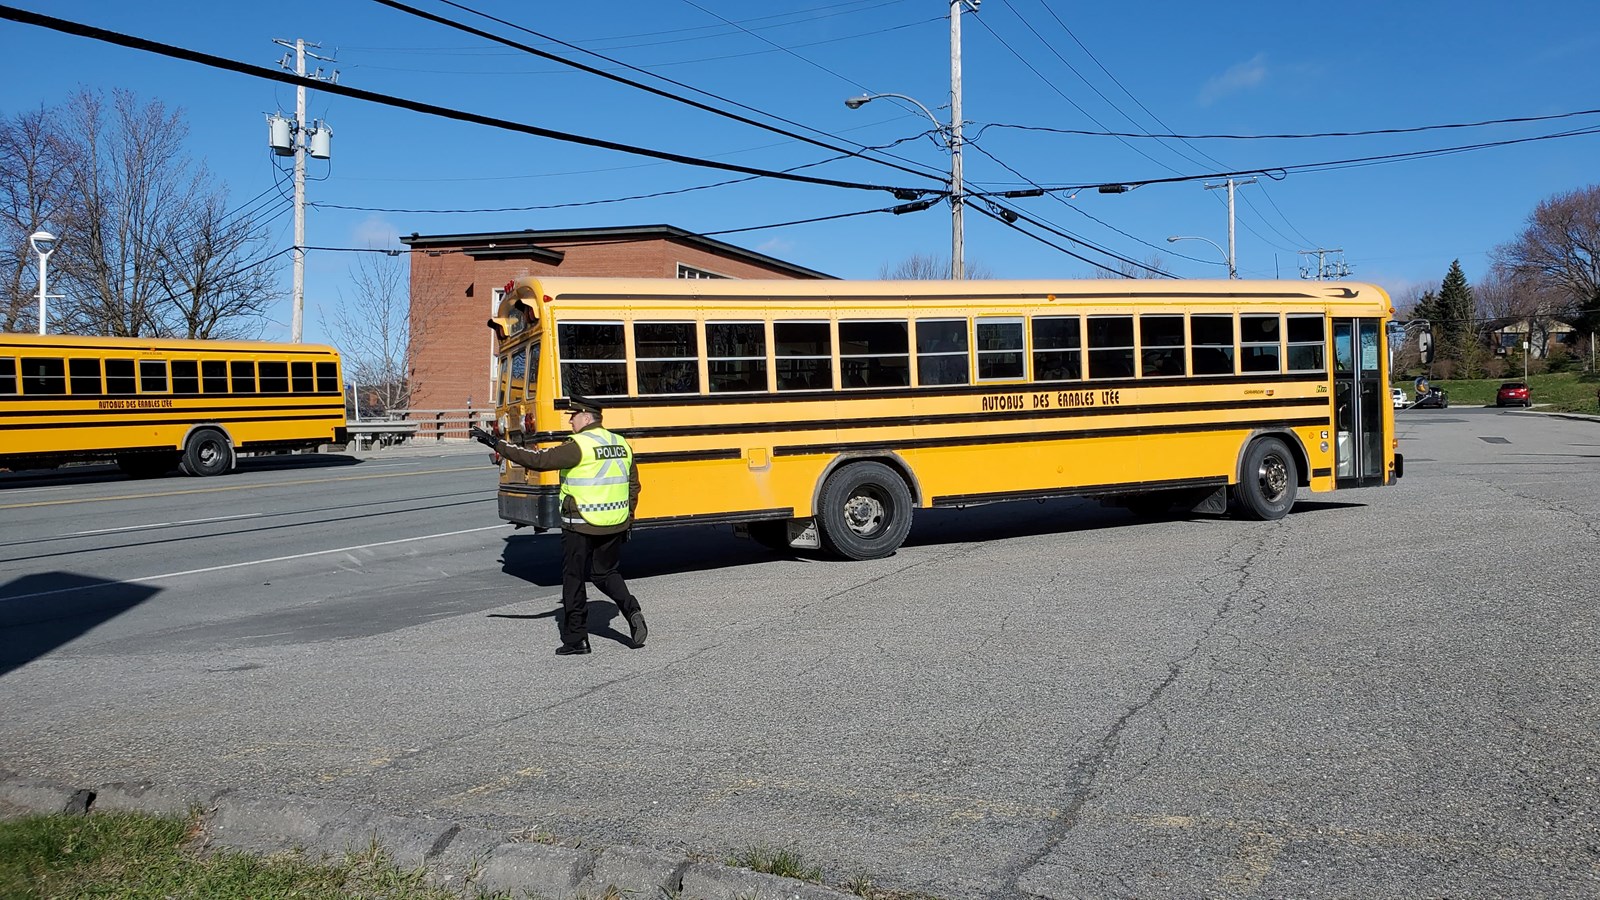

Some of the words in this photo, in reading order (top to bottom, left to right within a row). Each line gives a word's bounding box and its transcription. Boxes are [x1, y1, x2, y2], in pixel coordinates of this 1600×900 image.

[98, 400, 125, 409] AUTOBUS
[126, 400, 137, 408] DES
[161, 399, 173, 408] LTÉE
[982, 394, 1024, 411] AUTOBUS
[1033, 393, 1050, 409] DES
[1057, 391, 1095, 407] ÉRABLES
[1101, 389, 1120, 405] LTÉE
[596, 447, 627, 459] POLICE
